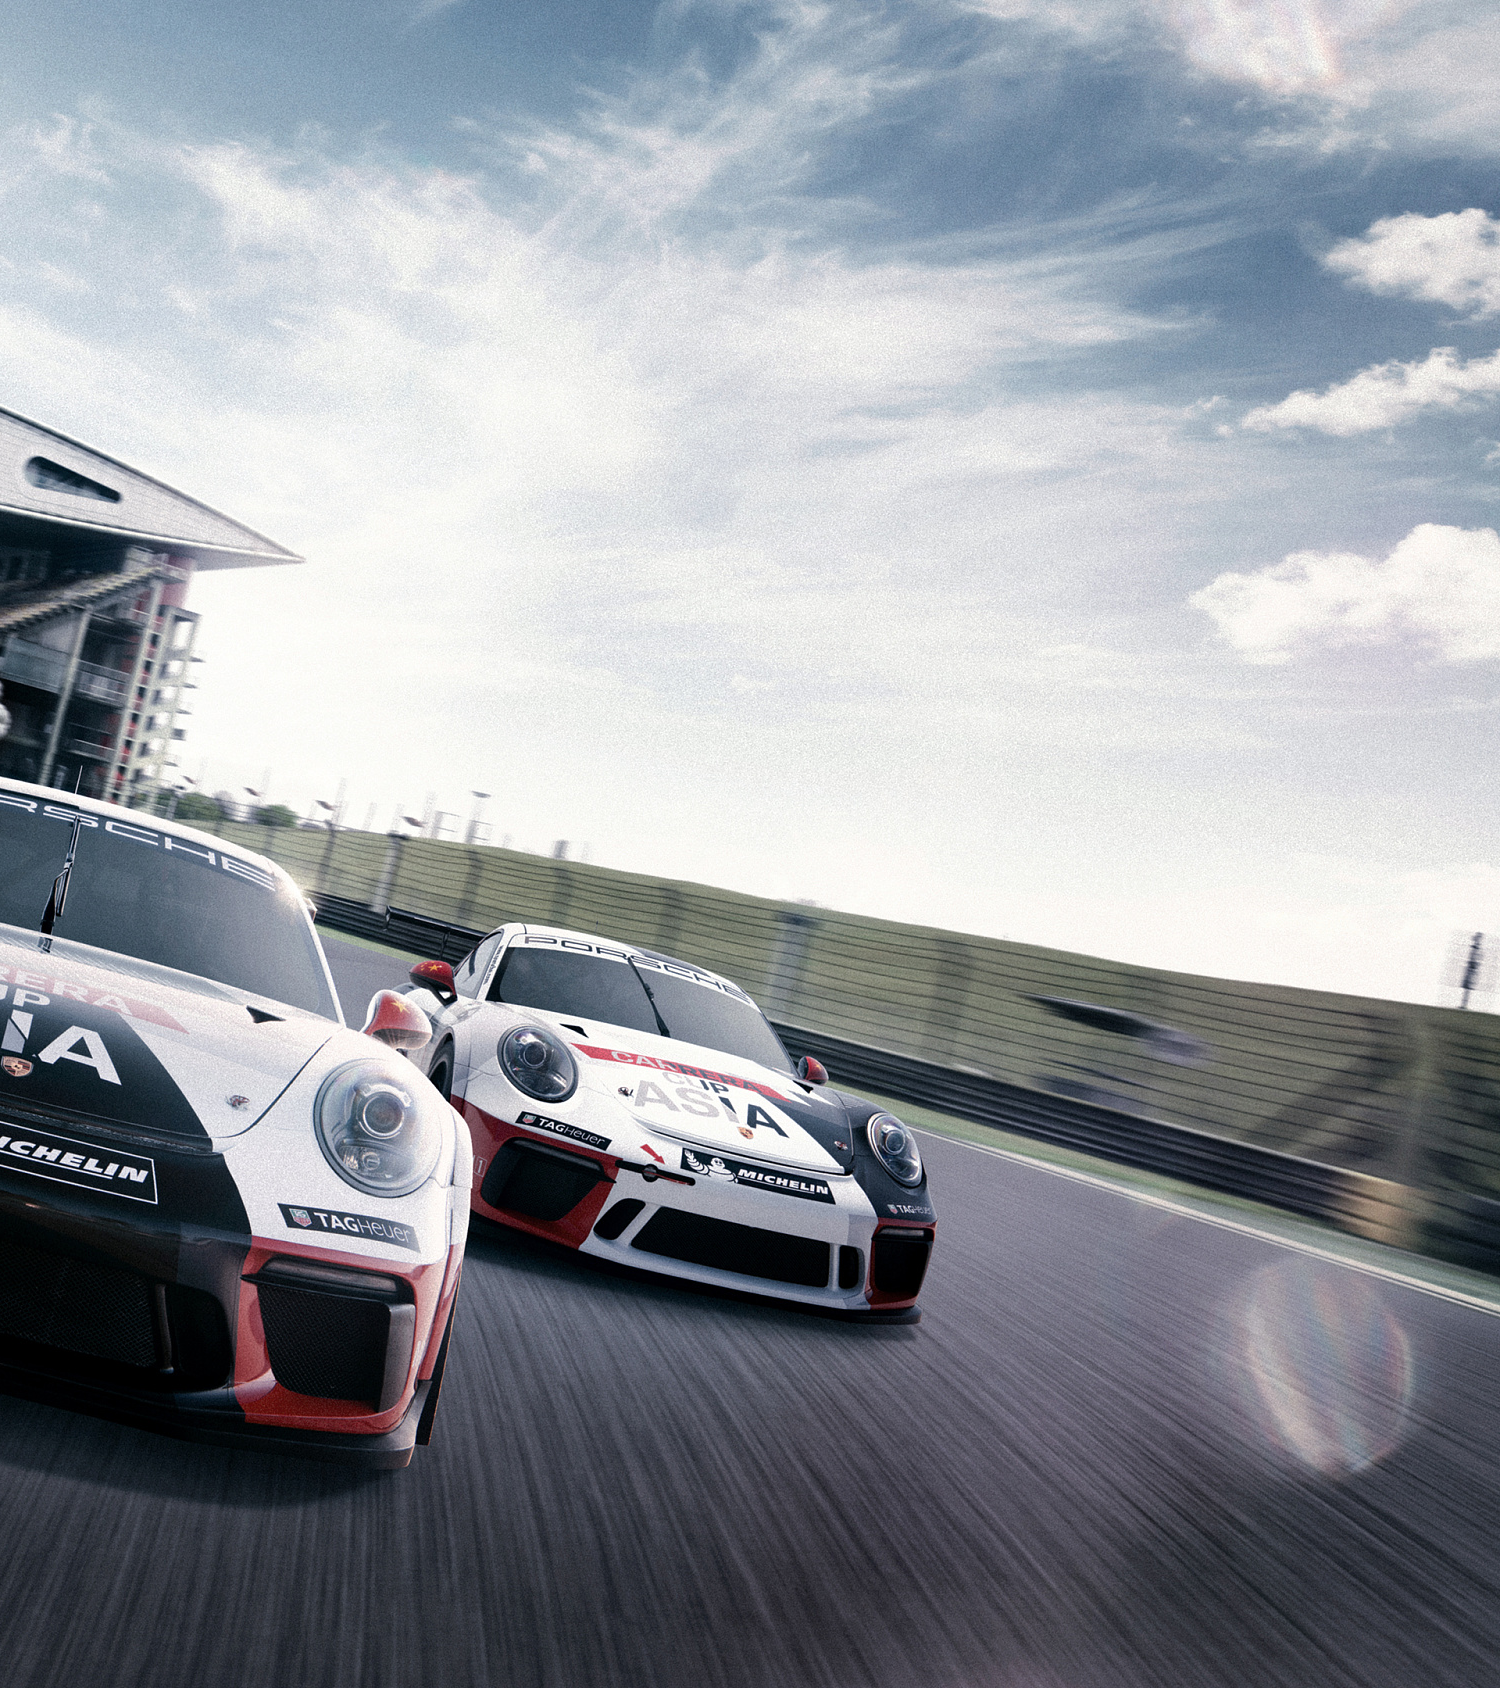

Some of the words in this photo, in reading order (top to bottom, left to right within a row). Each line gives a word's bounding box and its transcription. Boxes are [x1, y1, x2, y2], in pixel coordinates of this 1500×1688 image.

[524, 936, 751, 1004] PORSCHE
[611, 1051, 764, 1094] CARRERA
[662, 1072, 729, 1094] CUP
[634, 1080, 790, 1138] ASIA
[738, 1169, 829, 1195] MICHELIN
